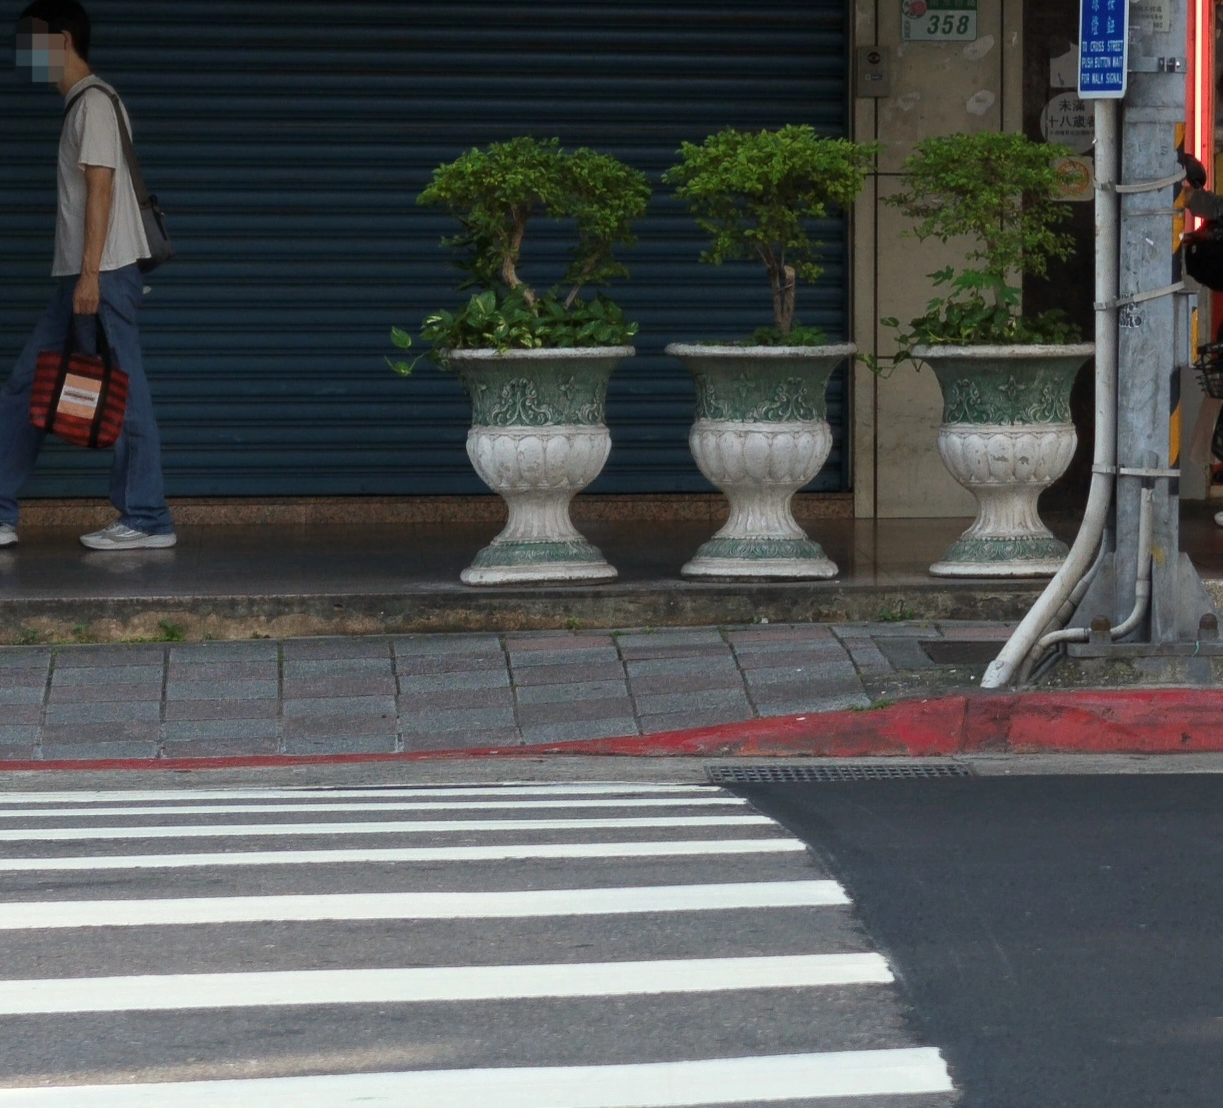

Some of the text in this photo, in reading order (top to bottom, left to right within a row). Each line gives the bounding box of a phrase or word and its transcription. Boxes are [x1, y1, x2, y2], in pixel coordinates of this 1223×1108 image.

[927, 15, 969, 35] 358
[1082, 40, 1124, 52] TO CROSS STREET
[1081, 56, 1123, 69] PUSH BUTTON WAIT
[1081, 72, 1123, 85] FOR WALK SIGNAL
[1059, 99, 1085, 112] 未滿
